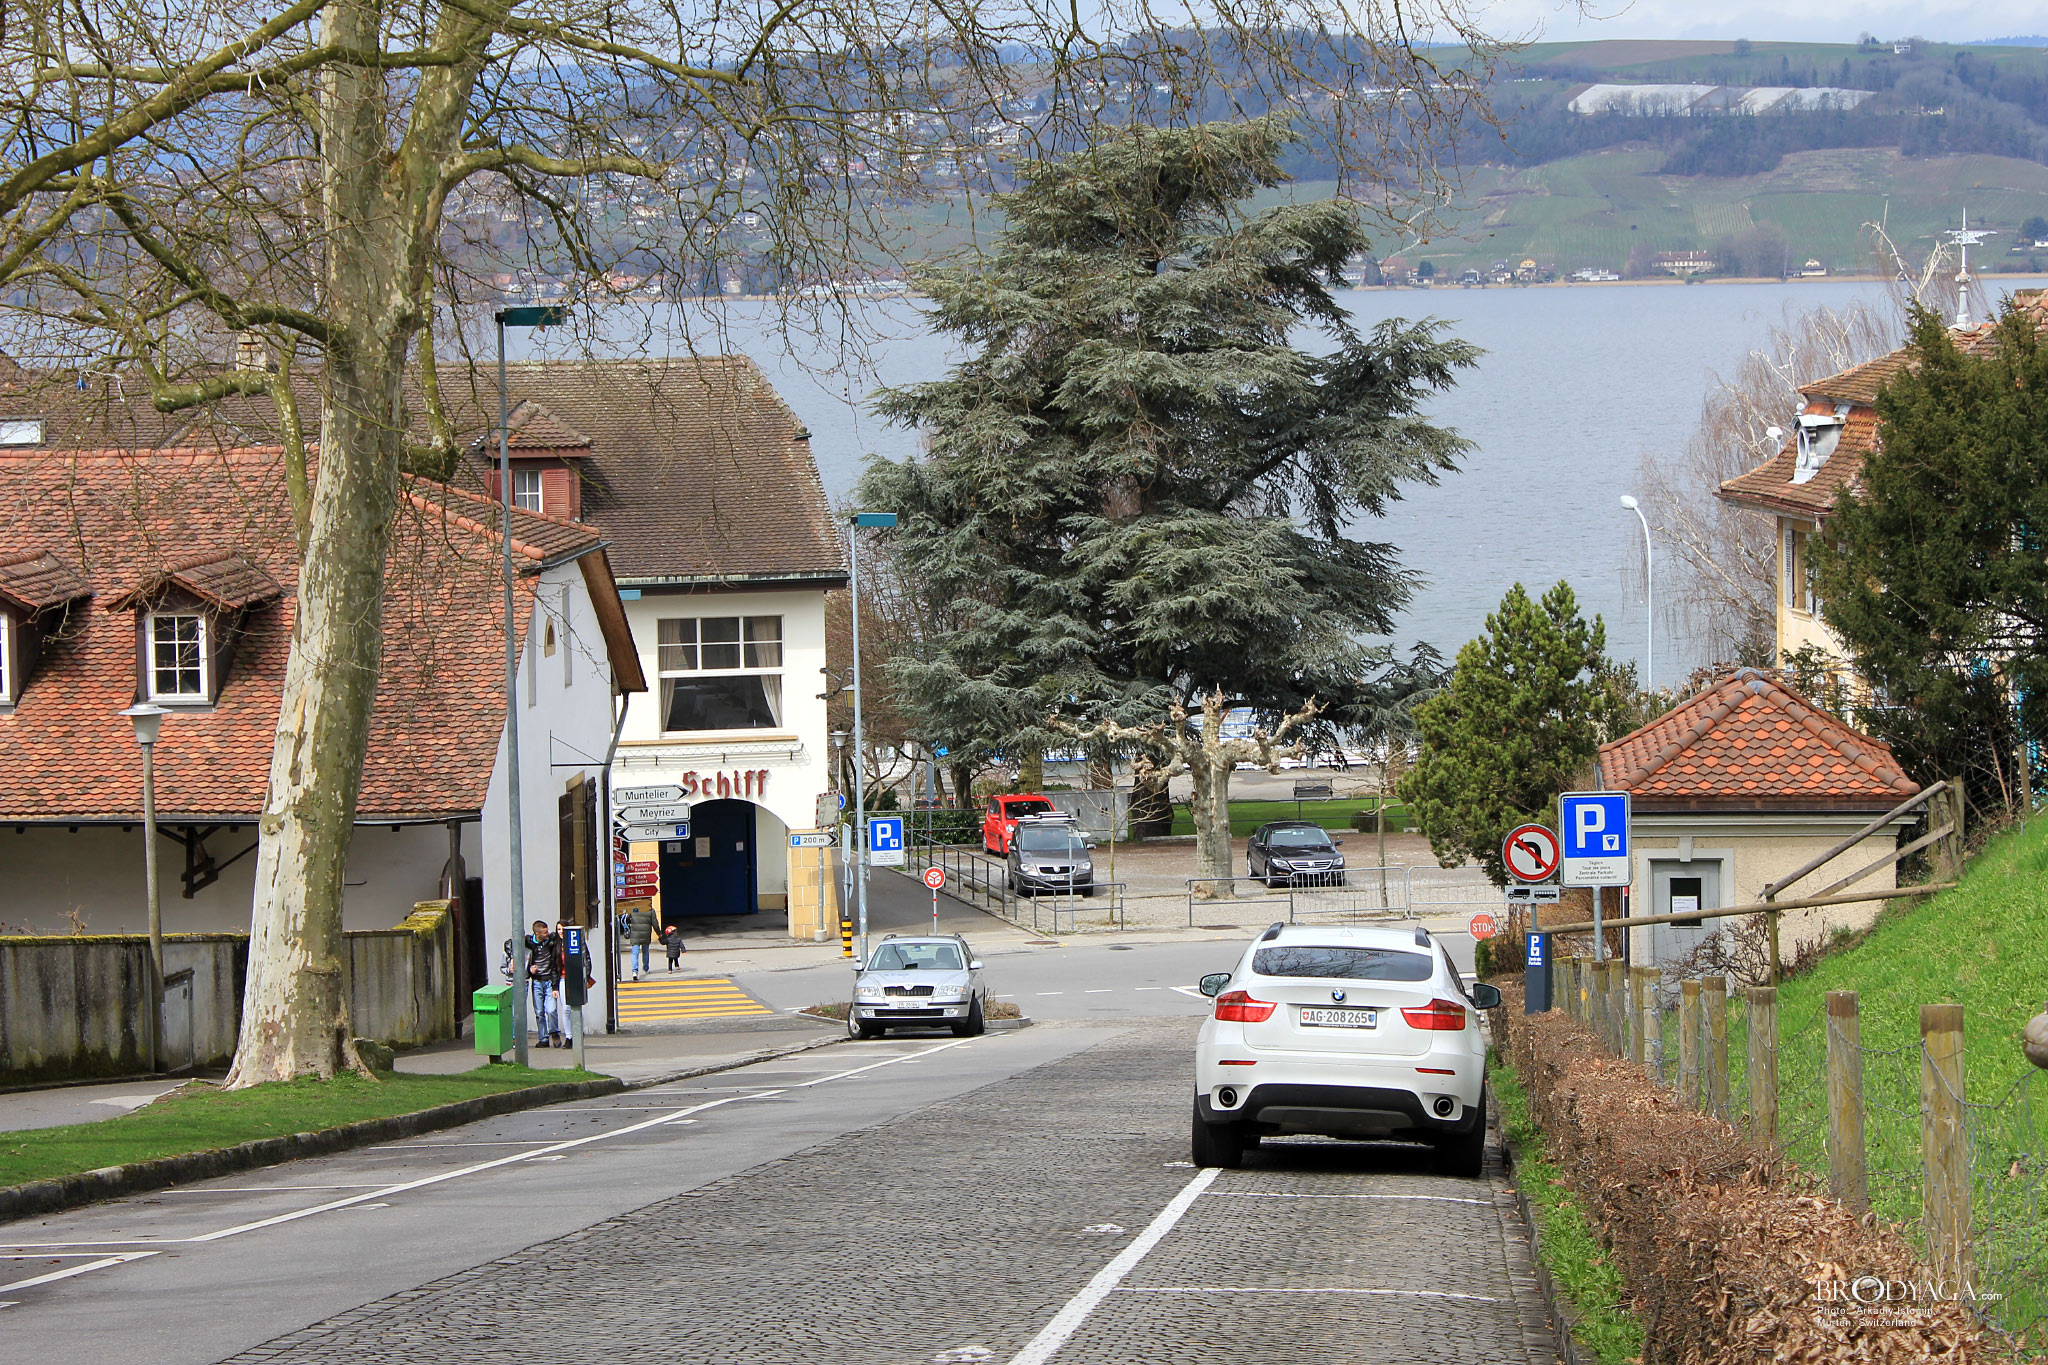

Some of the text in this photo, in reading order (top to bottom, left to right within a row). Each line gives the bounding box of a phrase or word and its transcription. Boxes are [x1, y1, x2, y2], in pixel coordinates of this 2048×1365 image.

[682, 769, 770, 799] Schiff
[625, 789, 669, 800] Muntelier
[640, 808, 675, 819] Meyriez
[1576, 804, 1605, 848] P
[644, 828, 660, 837] City
[877, 824, 891, 846] P
[1472, 923, 1494, 932] STOP
[1531, 935, 1540, 947] P
